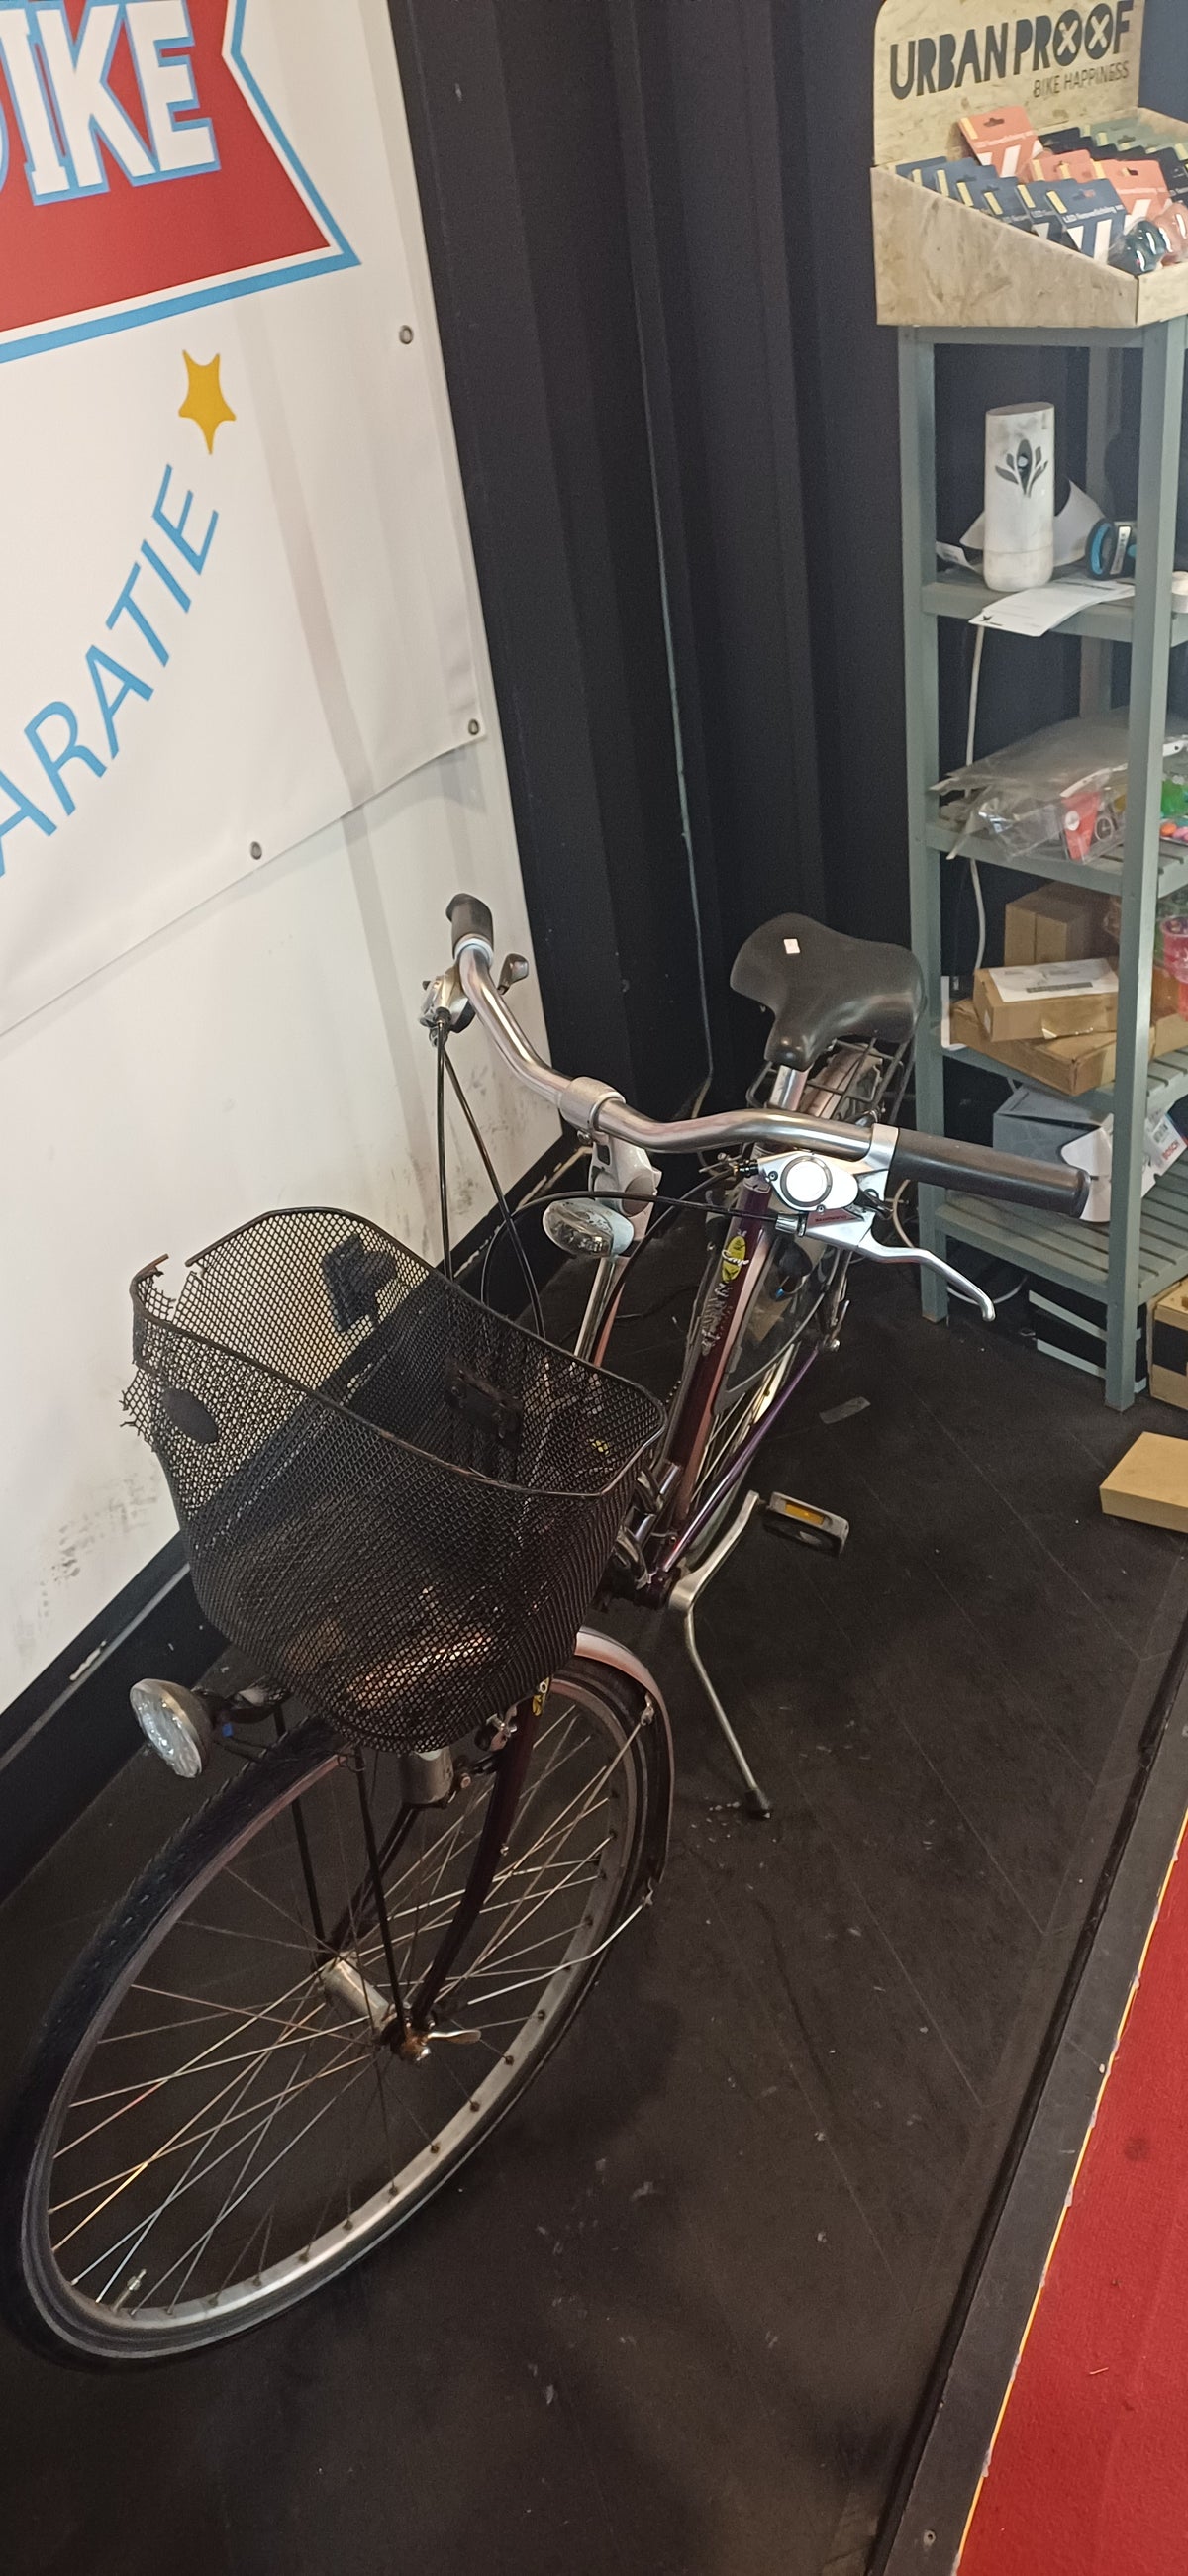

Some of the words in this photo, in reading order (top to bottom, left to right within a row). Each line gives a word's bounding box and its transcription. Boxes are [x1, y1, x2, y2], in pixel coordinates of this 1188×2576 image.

[0, 0, 220, 206] IKE
[1033, 74, 1060, 98] BIKE
[1063, 60, 1130, 91] HAPPINESS
